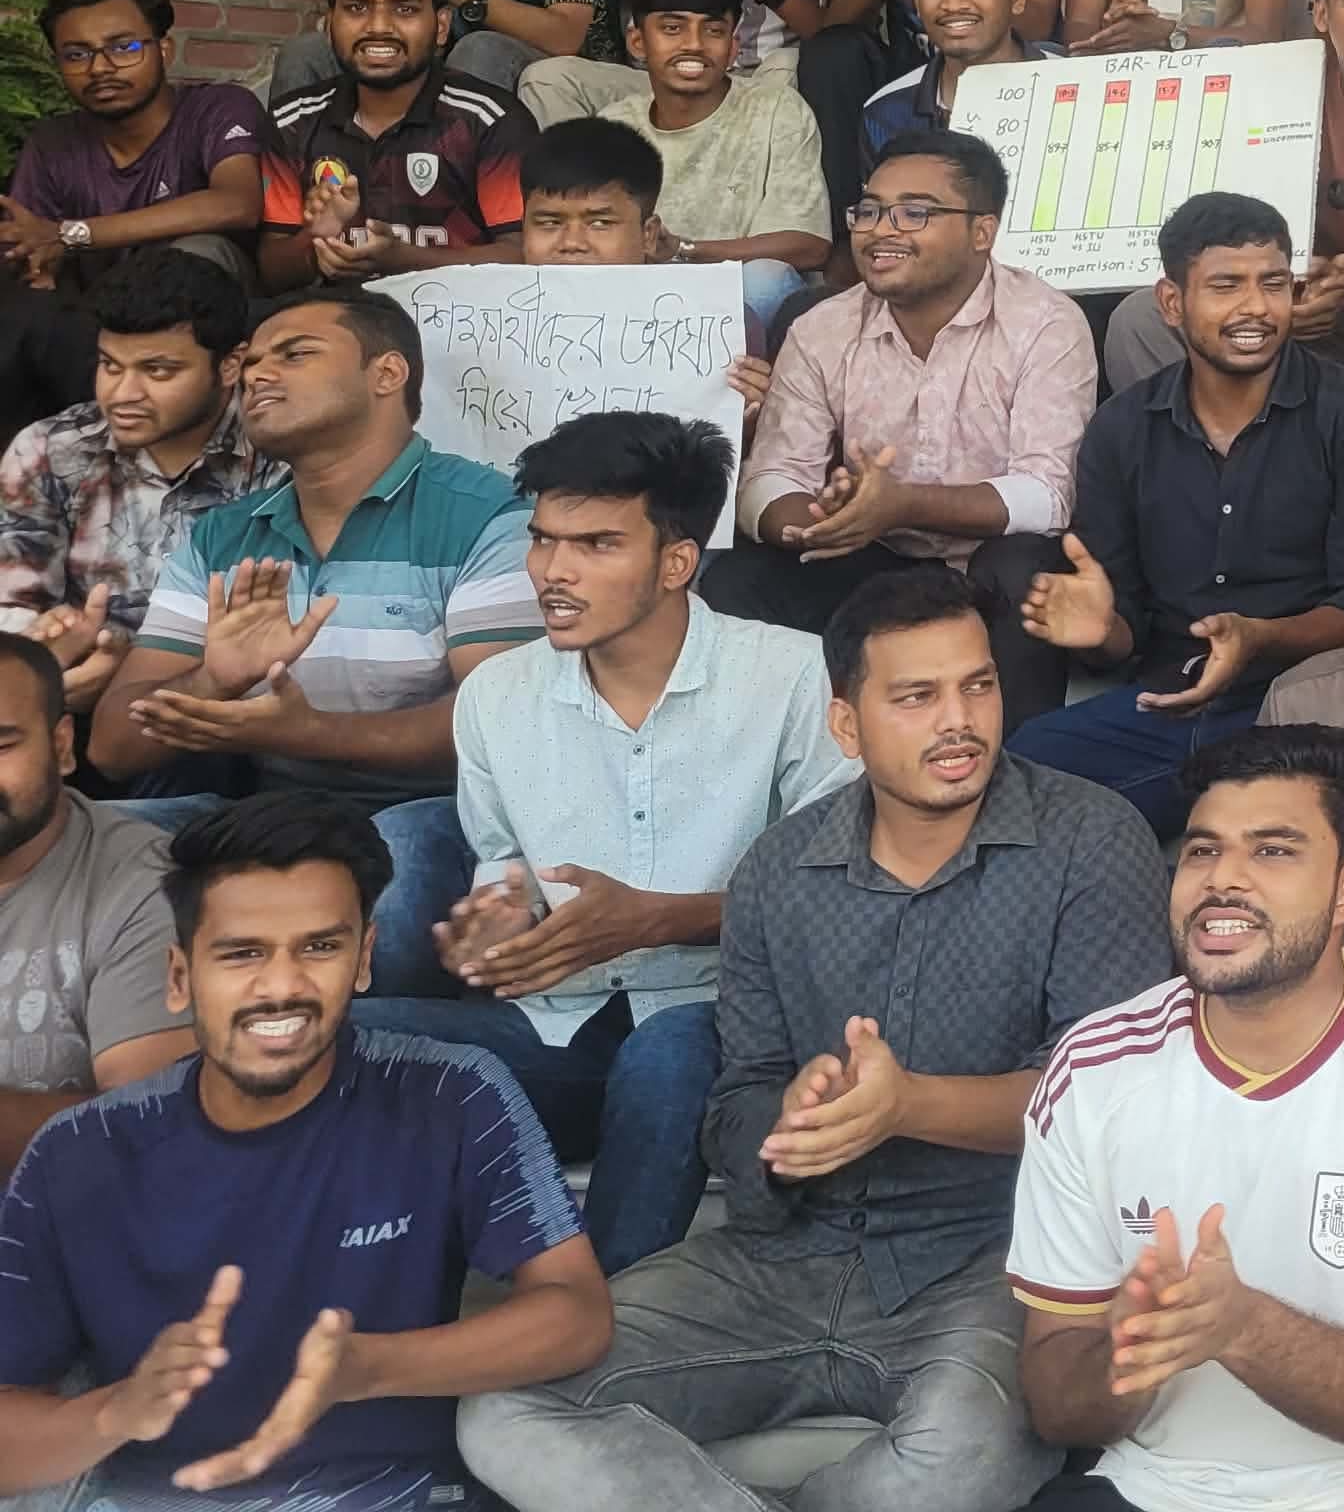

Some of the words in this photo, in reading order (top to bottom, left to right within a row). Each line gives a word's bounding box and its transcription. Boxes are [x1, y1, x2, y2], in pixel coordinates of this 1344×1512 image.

[995, 87, 1026, 102] 100
[996, 118, 1020, 136] 80
[456, 366, 533, 436] নিয়ে
